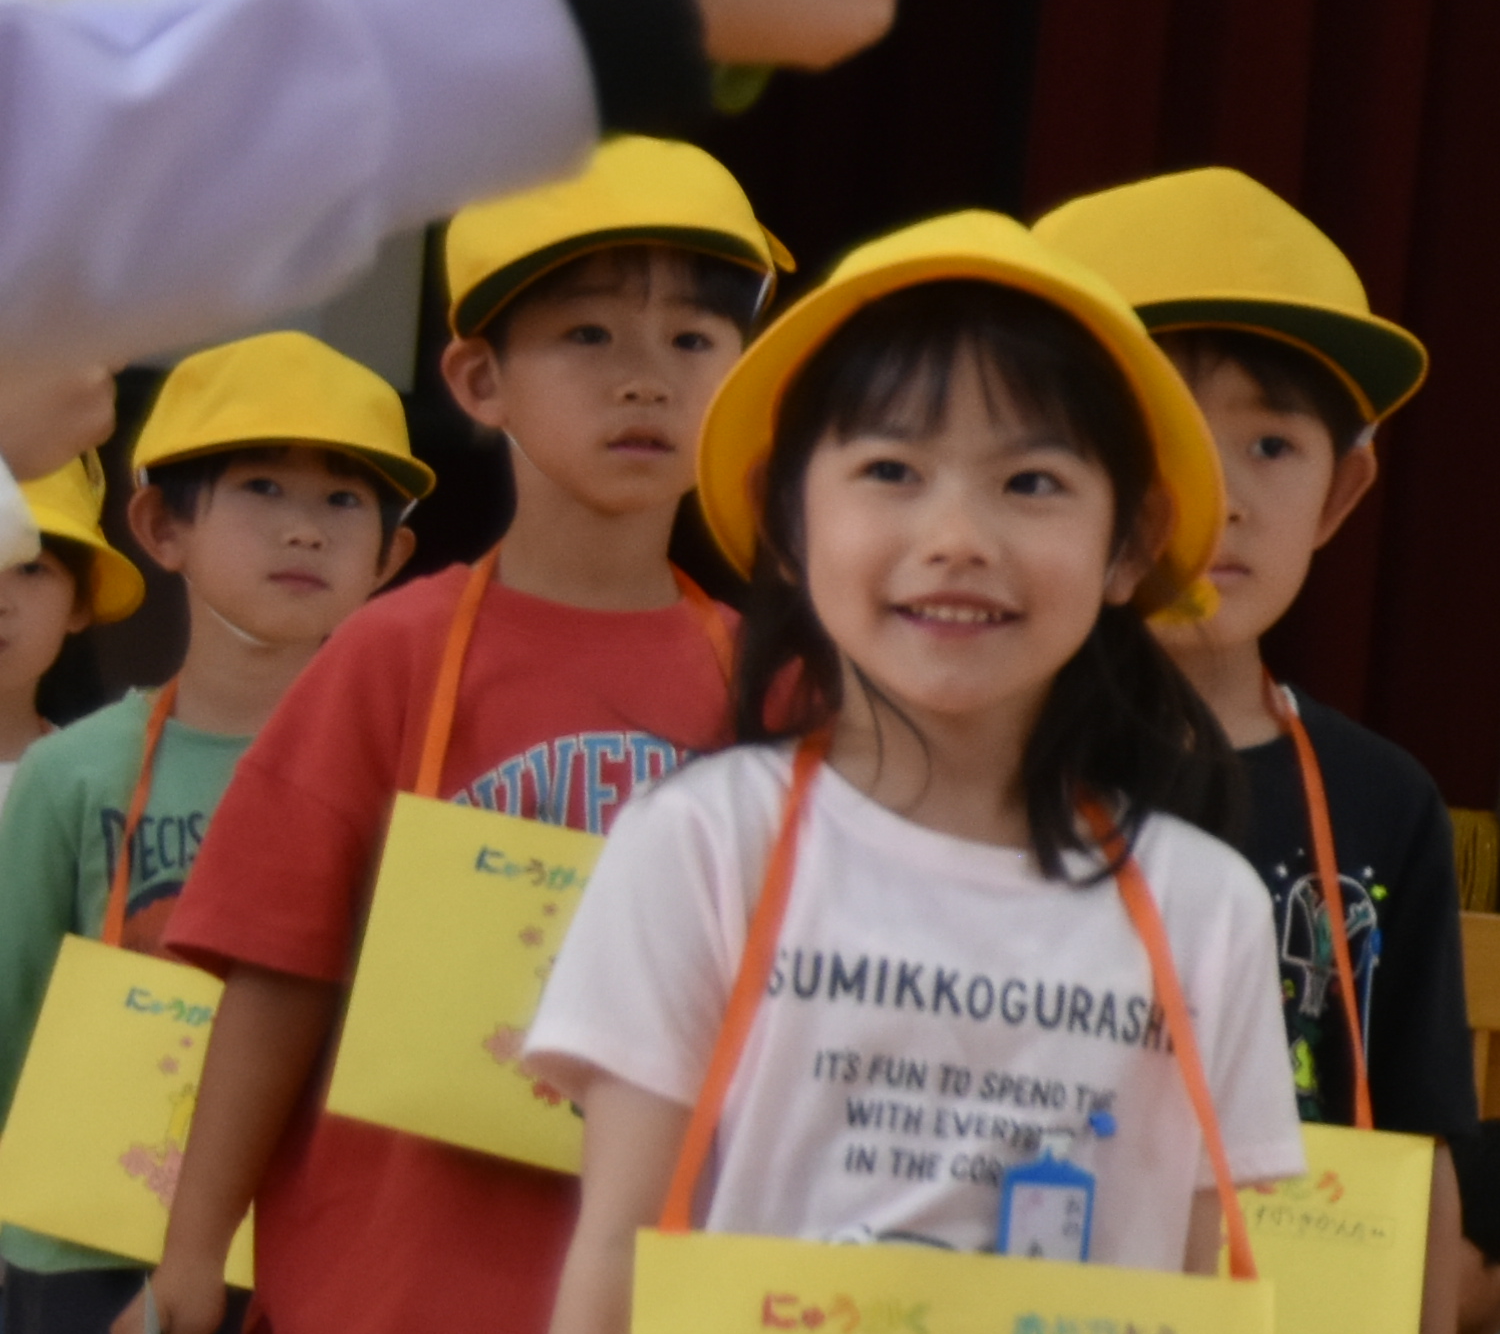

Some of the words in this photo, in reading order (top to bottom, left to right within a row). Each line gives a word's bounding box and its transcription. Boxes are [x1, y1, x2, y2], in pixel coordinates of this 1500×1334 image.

[474, 844, 592, 891] にゅうが
[767, 949, 1185, 1054] SUMIKKOGURASH
[868, 1056, 927, 1092] FUN
[938, 1063, 972, 1095] TO
[979, 1074, 1067, 1111] SPEND
[846, 1097, 923, 1137] WITH
[845, 1144, 878, 1174] IN
[891, 1149, 939, 1181] THE
